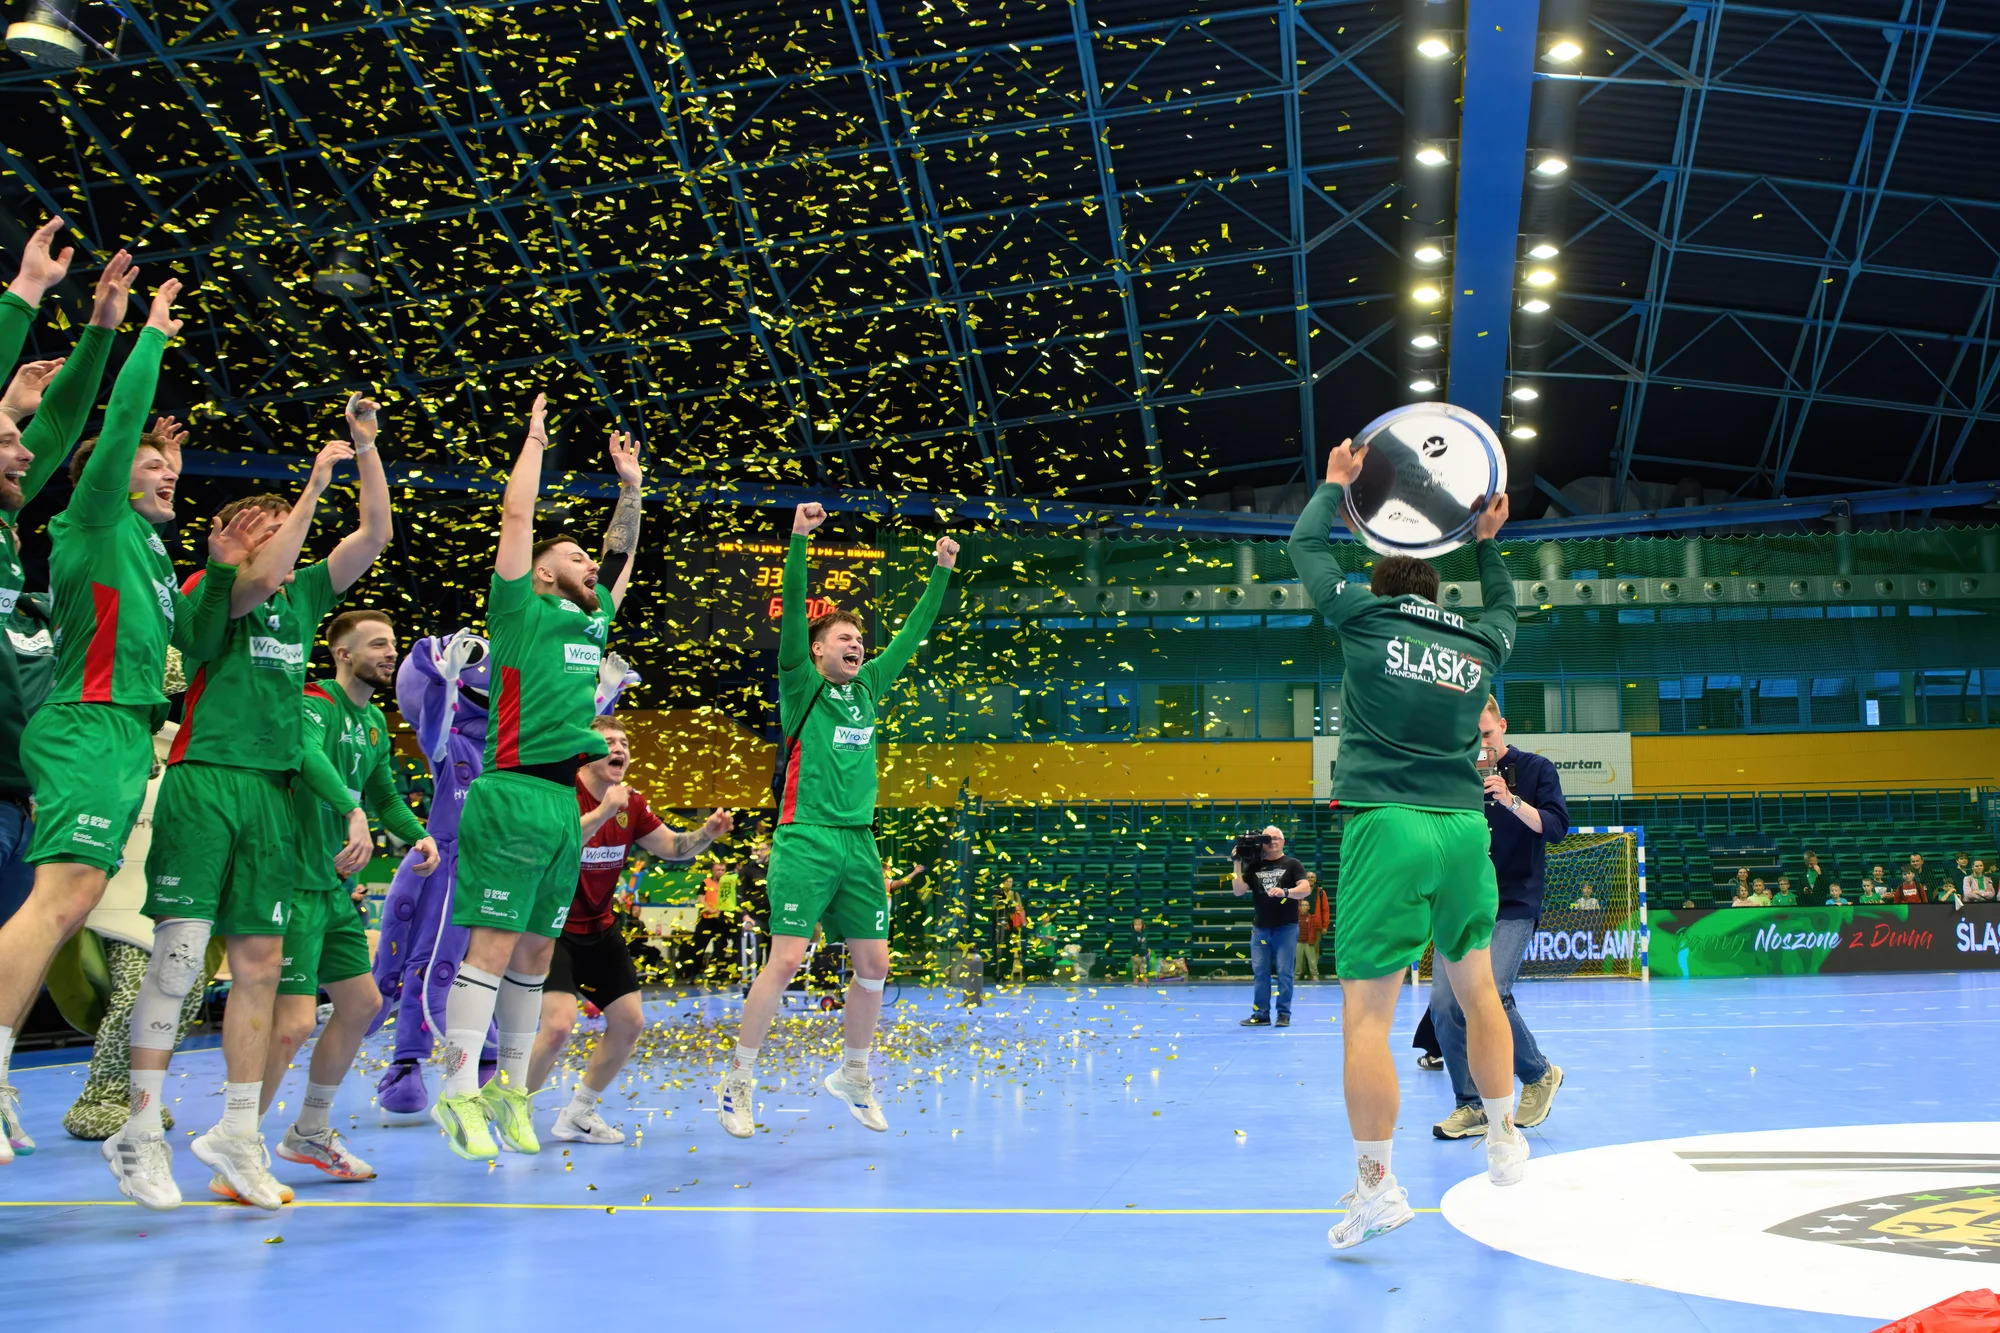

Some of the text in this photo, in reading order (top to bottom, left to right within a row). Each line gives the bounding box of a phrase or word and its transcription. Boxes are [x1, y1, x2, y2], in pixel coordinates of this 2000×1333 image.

[756, 567, 783, 587] 33
[267, 615, 280, 631] 4
[568, 646, 600, 661] Wroc
[350, 752, 361, 775] 7
[1553, 760, 1602, 770] partan
[271, 901, 283, 926] 4
[875, 911, 884, 931] 2
[1755, 923, 1842, 953] Noszone
[1849, 931, 1864, 949] z
[1955, 917, 2000, 955] ŚLĄ
